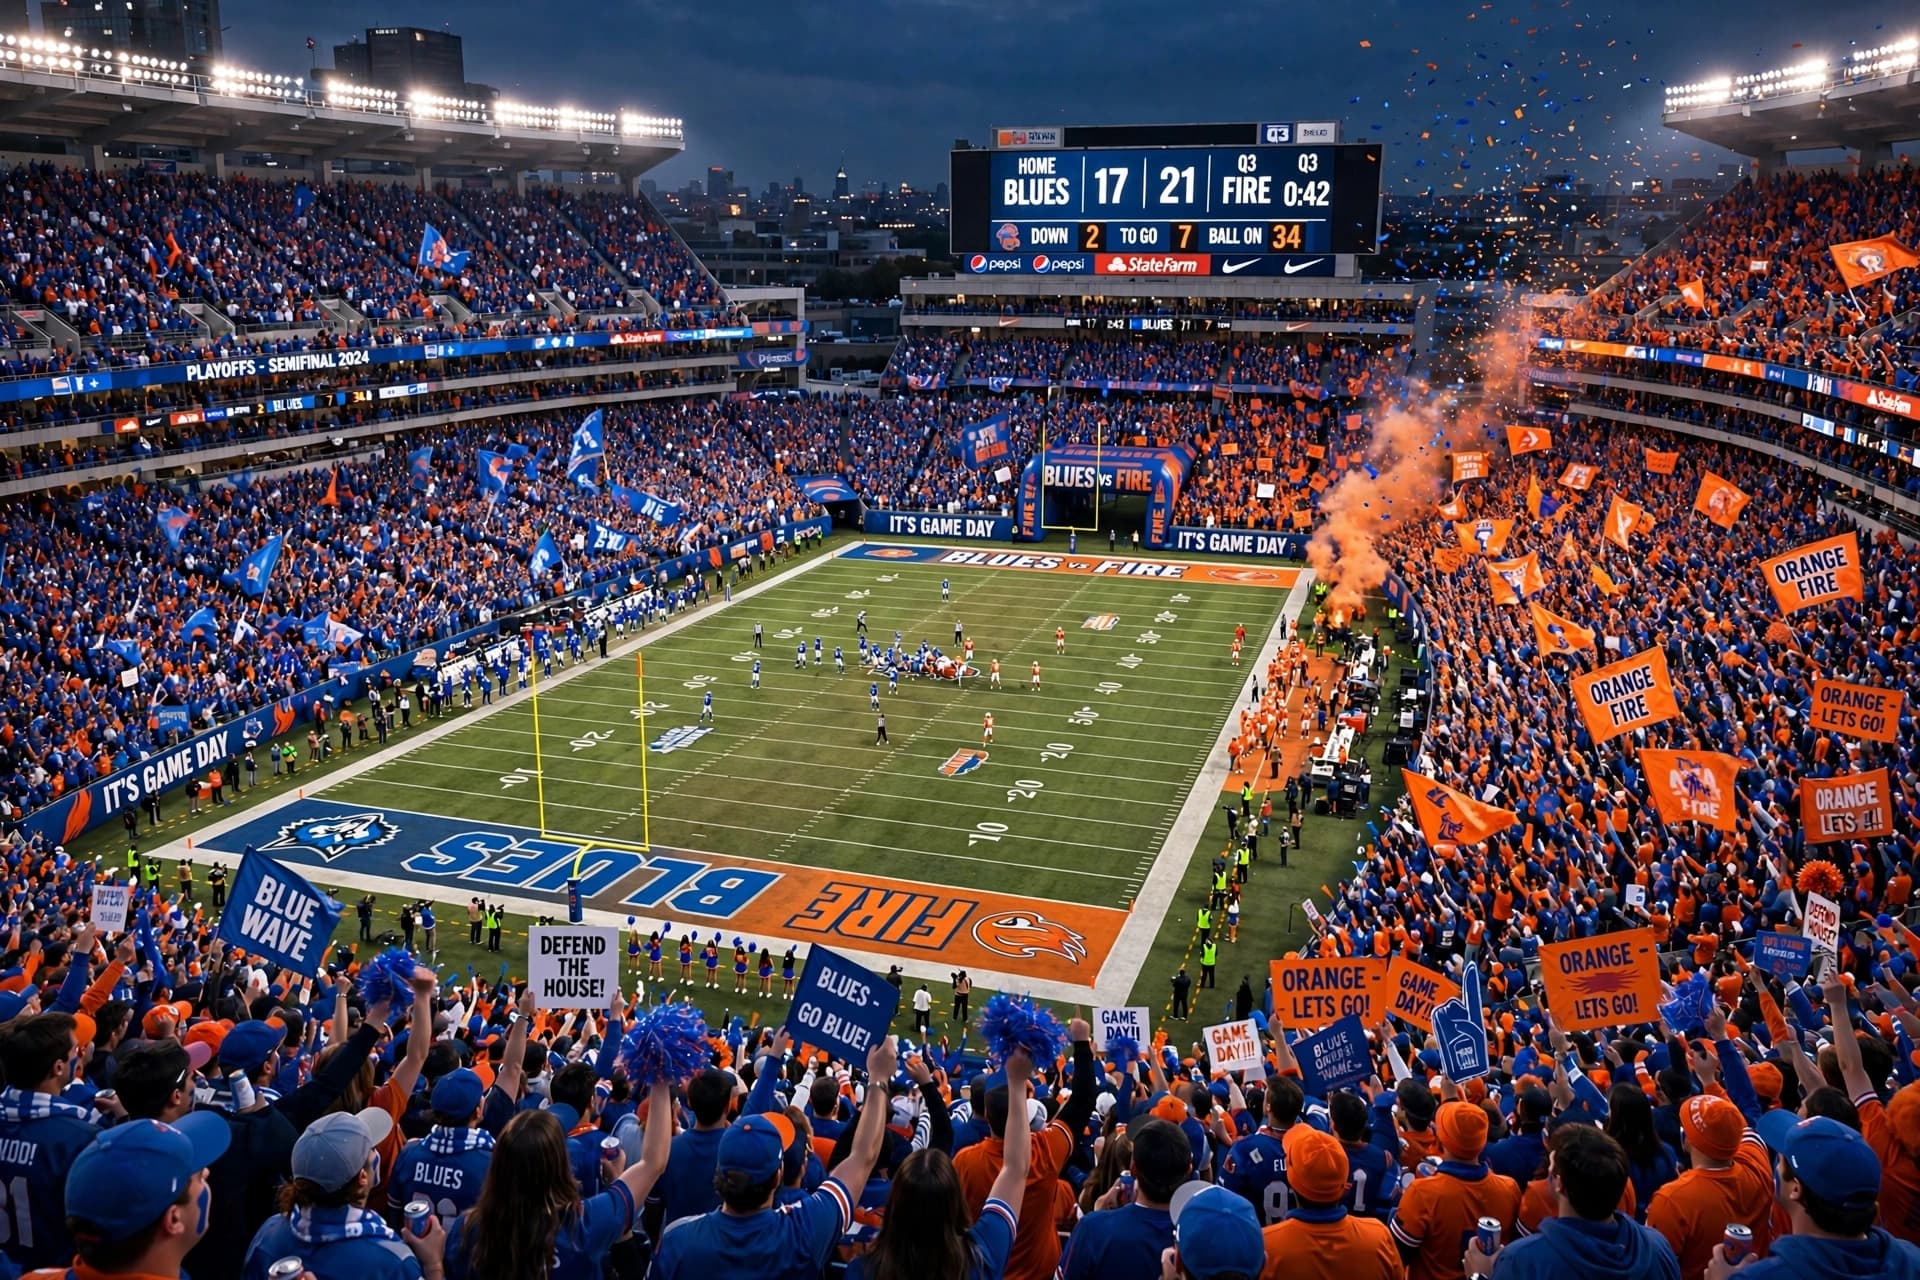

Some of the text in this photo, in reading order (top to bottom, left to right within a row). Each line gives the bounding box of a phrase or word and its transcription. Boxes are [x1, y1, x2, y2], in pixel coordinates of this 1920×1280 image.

[1018, 157, 1056, 175] HOME
[1238, 155, 1256, 173] Q3
[1299, 154, 1318, 173] Q3
[1004, 177, 1070, 205] BLUES
[1094, 168, 1129, 204] 17
[1159, 166, 1195, 204] 21
[1222, 176, 1272, 204] FIRE
[1284, 180, 1330, 207] 0:42
[1031, 228, 1068, 245] DOWN
[1086, 225, 1099, 248] 2
[1120, 228, 1158, 244] TO GO
[1179, 224, 1191, 248] 7
[1208, 228, 1262, 245] BALL ON
[1272, 224, 1300, 248] 34
[989, 257, 1021, 271] pepsi
[1052, 257, 1084, 271] pepsi
[1143, 319, 1173, 330] BLUES
[187, 360, 256, 381] PLAYOFFS
[269, 353, 336, 372] SEMIFINAL
[338, 350, 369, 366] 2024
[1044, 466, 1095, 488] BLUES
[1116, 469, 1152, 491] FIRE
[889, 515, 994, 538] IT'S GAME DAY
[1178, 531, 1287, 554] IT'S GAME DAY
[940, 551, 1064, 569] BLUES
[1094, 560, 1189, 578] FIRE
[1774, 547, 1848, 584] ORANGE
[1796, 573, 1839, 600] FIRE
[1590, 666, 1655, 706] ORANGE
[1609, 694, 1649, 726] FIRE
[1820, 687, 1886, 713] ORANGE
[1822, 708, 1856, 729] LETS
[1860, 712, 1885, 734] GO!
[102, 731, 228, 814] IT'S GAME DAY
[1816, 781, 1880, 810] ORANGE
[401, 830, 786, 919] BLUES
[254, 874, 321, 929] BLUE
[784, 880, 980, 952] FIRE
[240, 904, 313, 962] WAVE
[540, 936, 606, 955] DEFEND
[558, 958, 590, 977] THE
[1560, 942, 1634, 975] ORANGE
[543, 978, 604, 998] HOUSE!
[816, 966, 871, 1007] BLUES
[1281, 967, 1364, 992] ORANGE
[1400, 971, 1439, 1001] GAME
[1101, 1010, 1137, 1025] GAME
[1292, 993, 1371, 1018] LETS GO!
[1575, 994, 1638, 1020] LETS GO!
[798, 1001, 872, 1053] GO BLUE!
[1212, 1023, 1249, 1042] GAME
[1215, 1041, 1255, 1062] DAY!!!
[414, 1162, 463, 1189] BLUES
